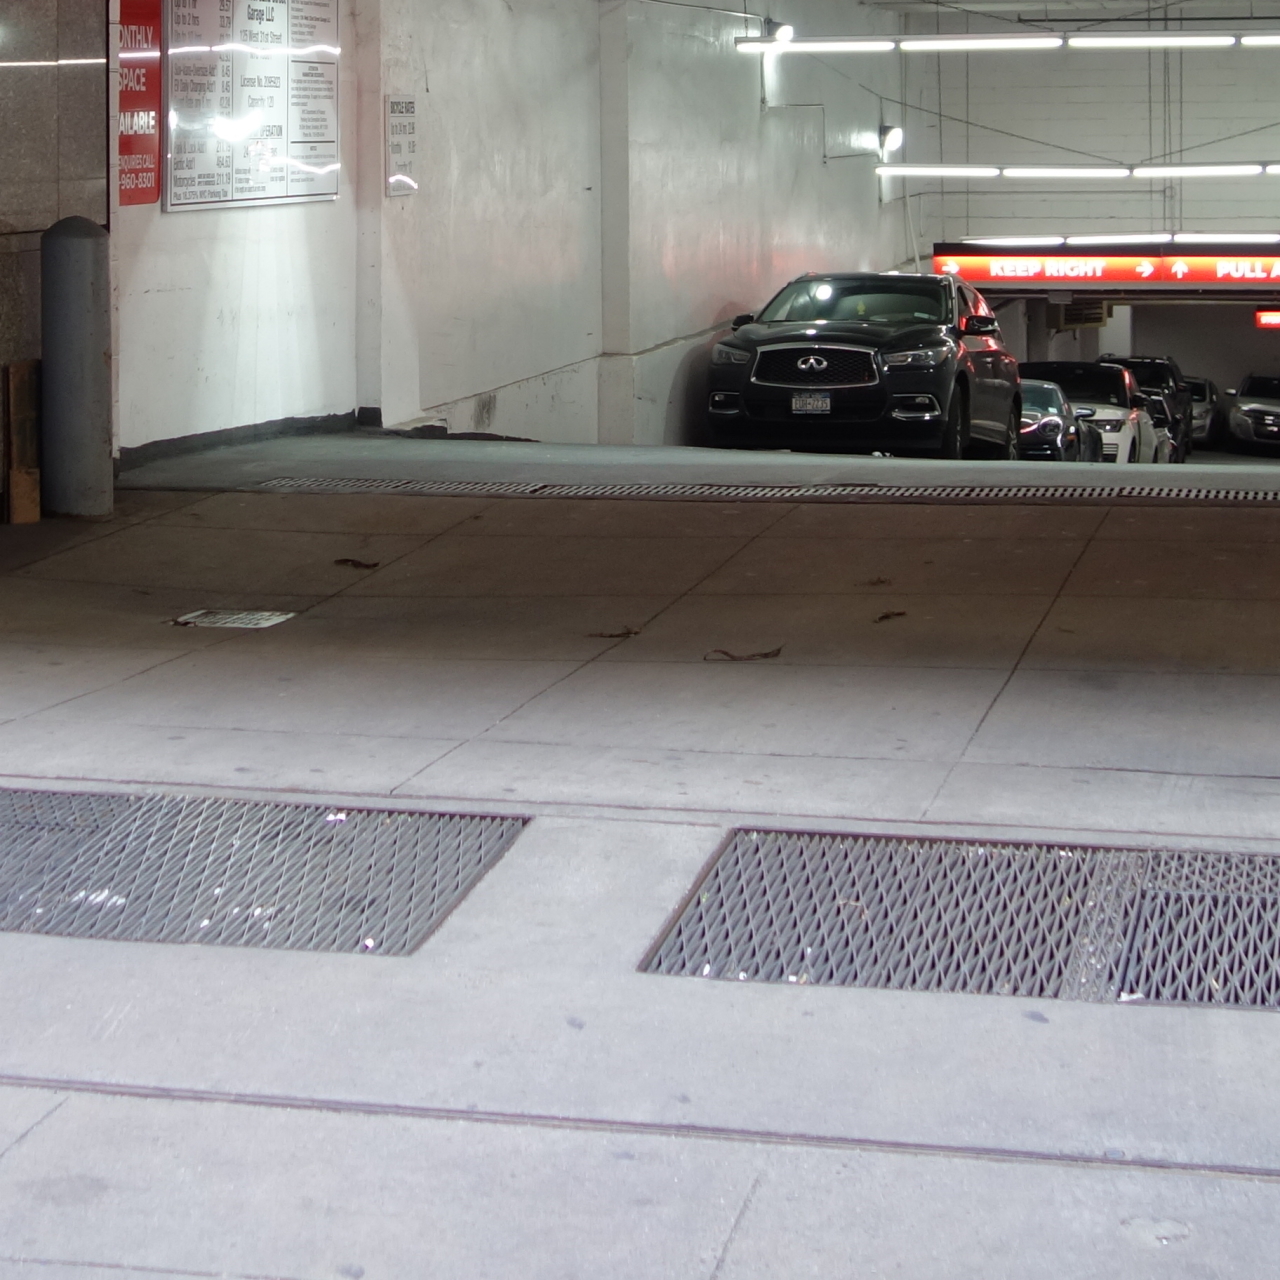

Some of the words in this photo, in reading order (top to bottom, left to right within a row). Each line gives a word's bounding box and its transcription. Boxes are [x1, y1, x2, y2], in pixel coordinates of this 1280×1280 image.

[174, 11, 181, 27] Up
[181, 13, 187, 25] to
[247, 4, 264, 25] Garage
[265, 6, 275, 22] LLC
[119, 24, 153, 48] ONTHLY
[270, 31, 282, 44] Street
[118, 111, 156, 135] AILABLE
[989, 261, 1041, 277] KEEP
[1045, 260, 1106, 277] RIGHT
[1216, 261, 1266, 278] PULL
